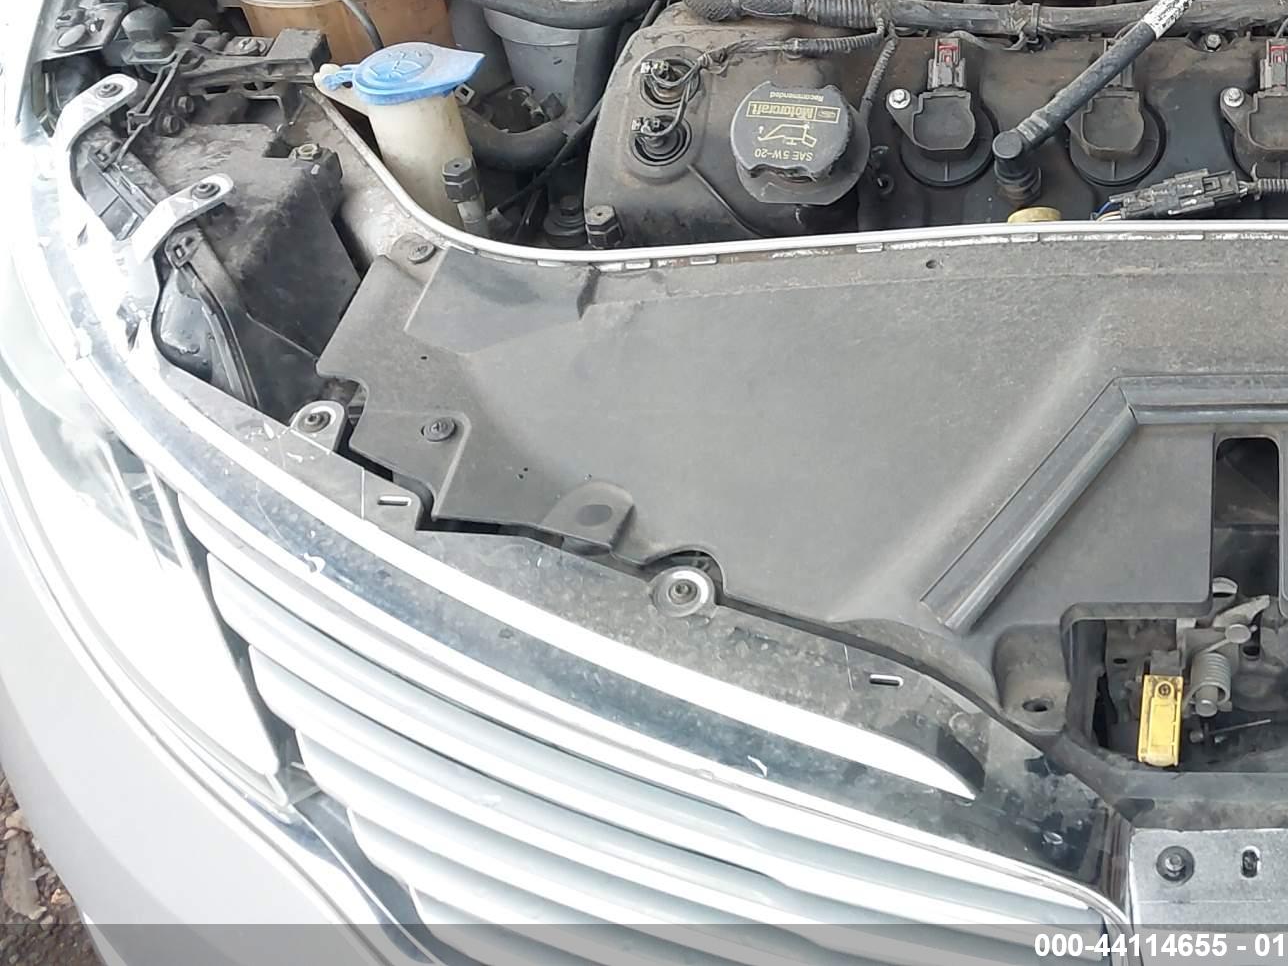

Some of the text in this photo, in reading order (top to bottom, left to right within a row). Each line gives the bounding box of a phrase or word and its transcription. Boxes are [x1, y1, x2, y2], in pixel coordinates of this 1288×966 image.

[769, 91, 824, 102] Recommended
[751, 103, 814, 120] Motorcraft
[754, 148, 814, 162] SAE 5W-20
